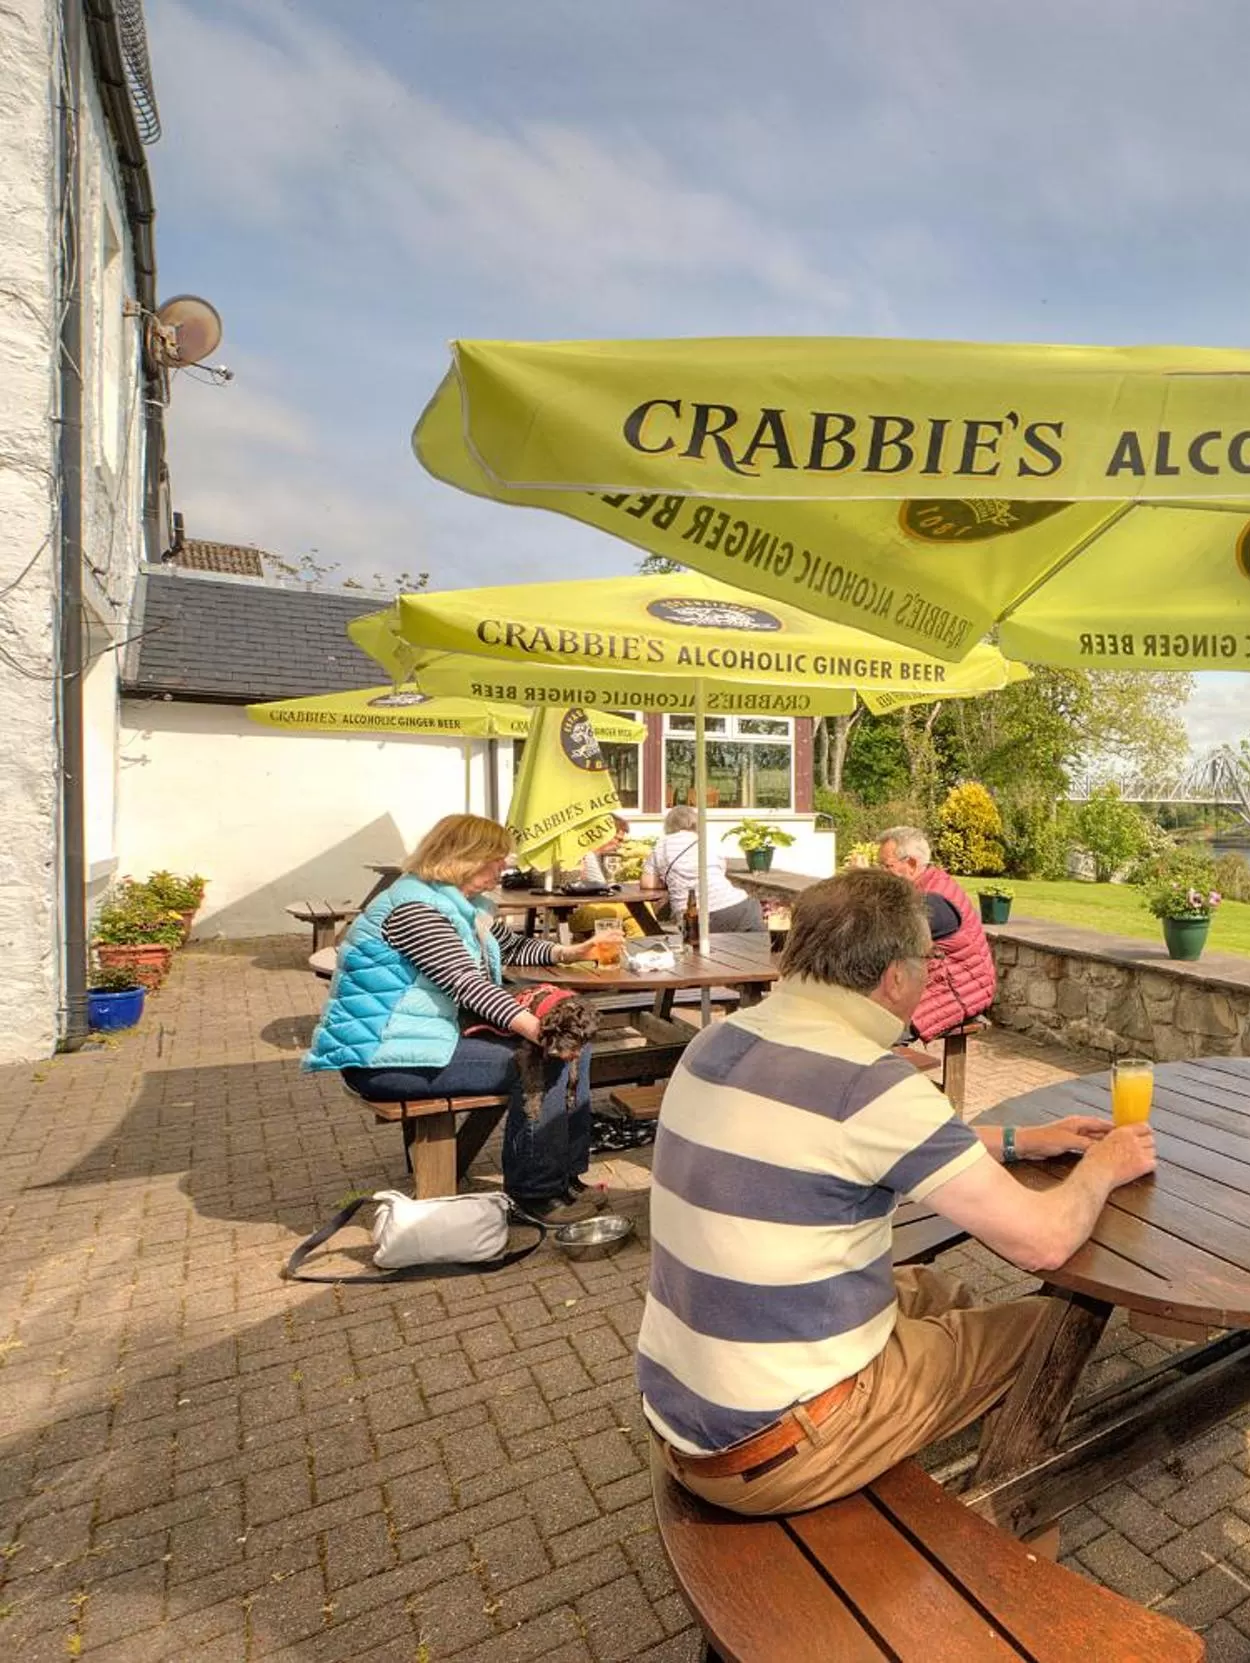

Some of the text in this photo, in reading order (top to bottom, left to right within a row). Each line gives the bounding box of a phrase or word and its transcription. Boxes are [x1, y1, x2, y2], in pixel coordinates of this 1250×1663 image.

[623, 399, 1064, 477] CRABBIE'S
[477, 619, 946, 682] CRABBIE'S ALCOHOLIC GINGER BEER
[343, 714, 396, 726] ALCOHOLIC
[398, 717, 435, 728] GINGER
